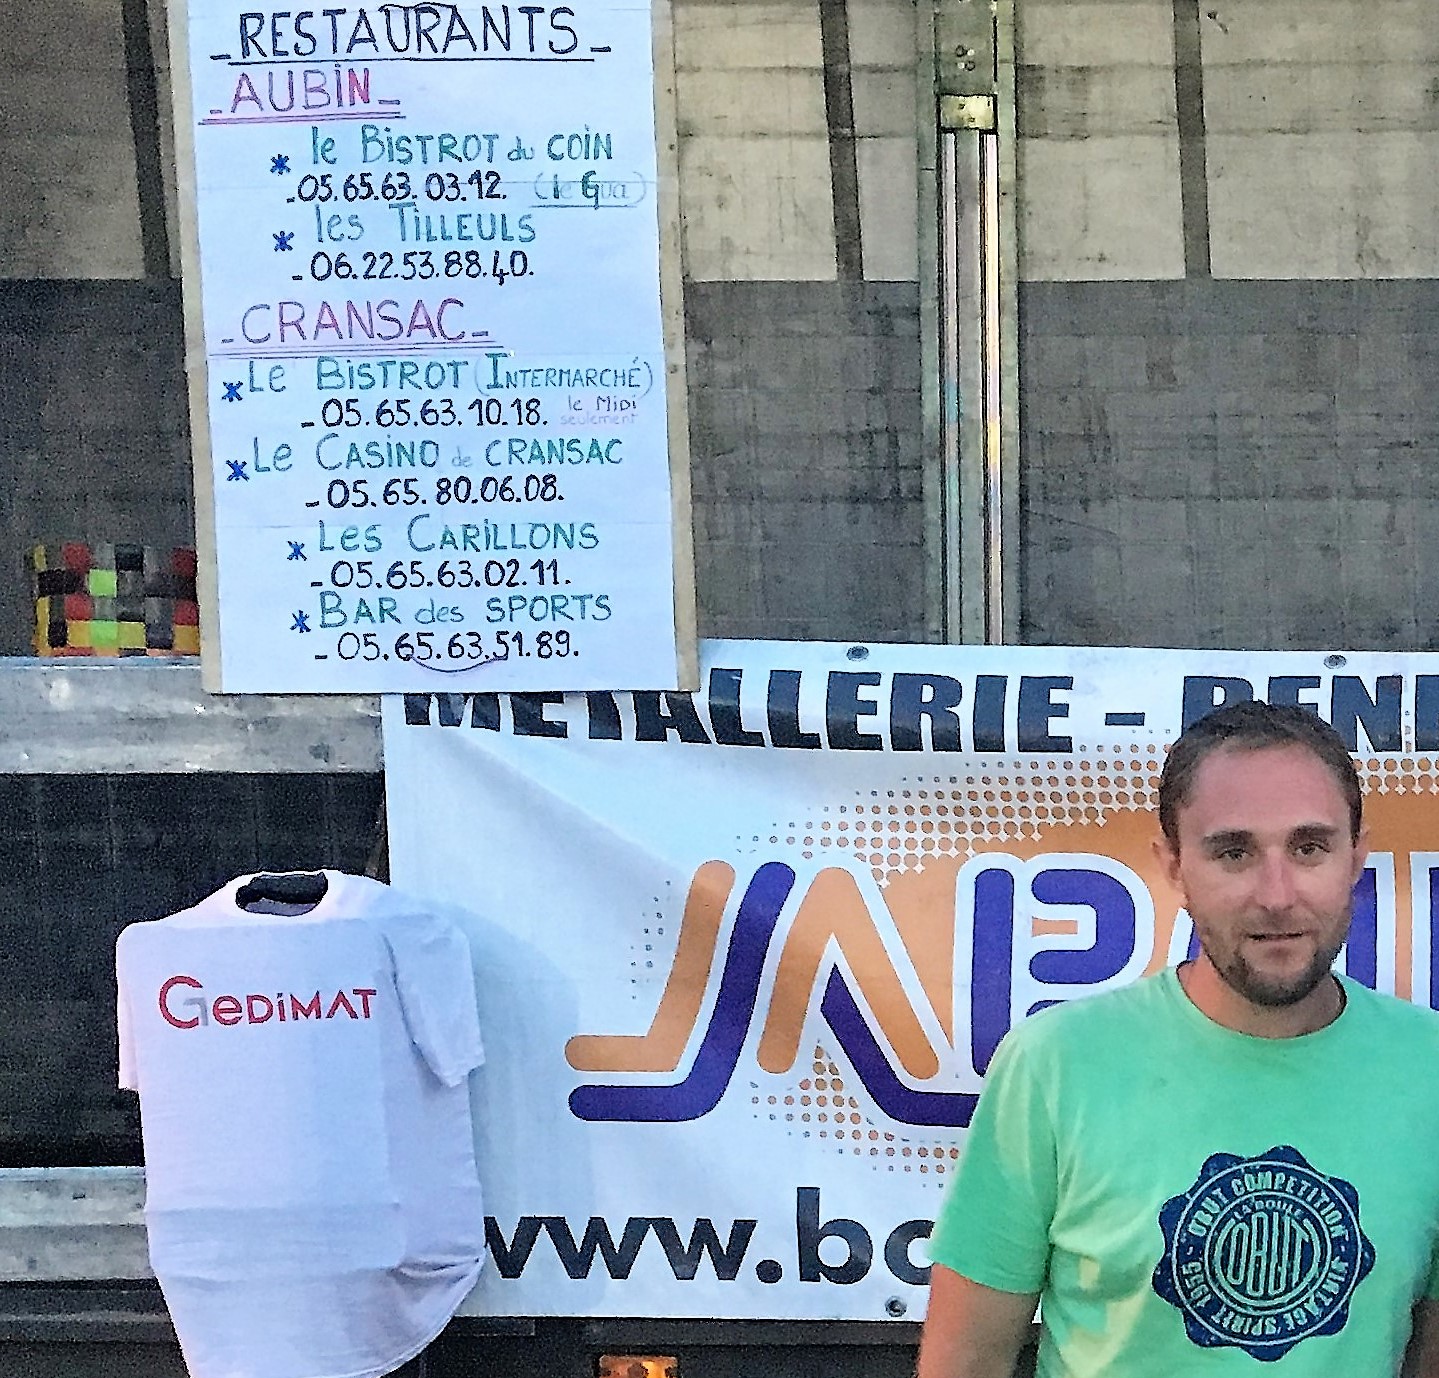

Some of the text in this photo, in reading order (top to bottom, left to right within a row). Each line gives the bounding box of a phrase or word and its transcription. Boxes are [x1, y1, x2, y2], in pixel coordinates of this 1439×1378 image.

[312, 126, 338, 165] le
[507, 135, 535, 161] du
[316, 206, 365, 243] les
[247, 361, 287, 394] Le
[252, 436, 293, 474] Le
[450, 446, 474, 469] de
[484, 437, 624, 467] CRANSAC
[318, 591, 612, 629] BAR des SPORTS
